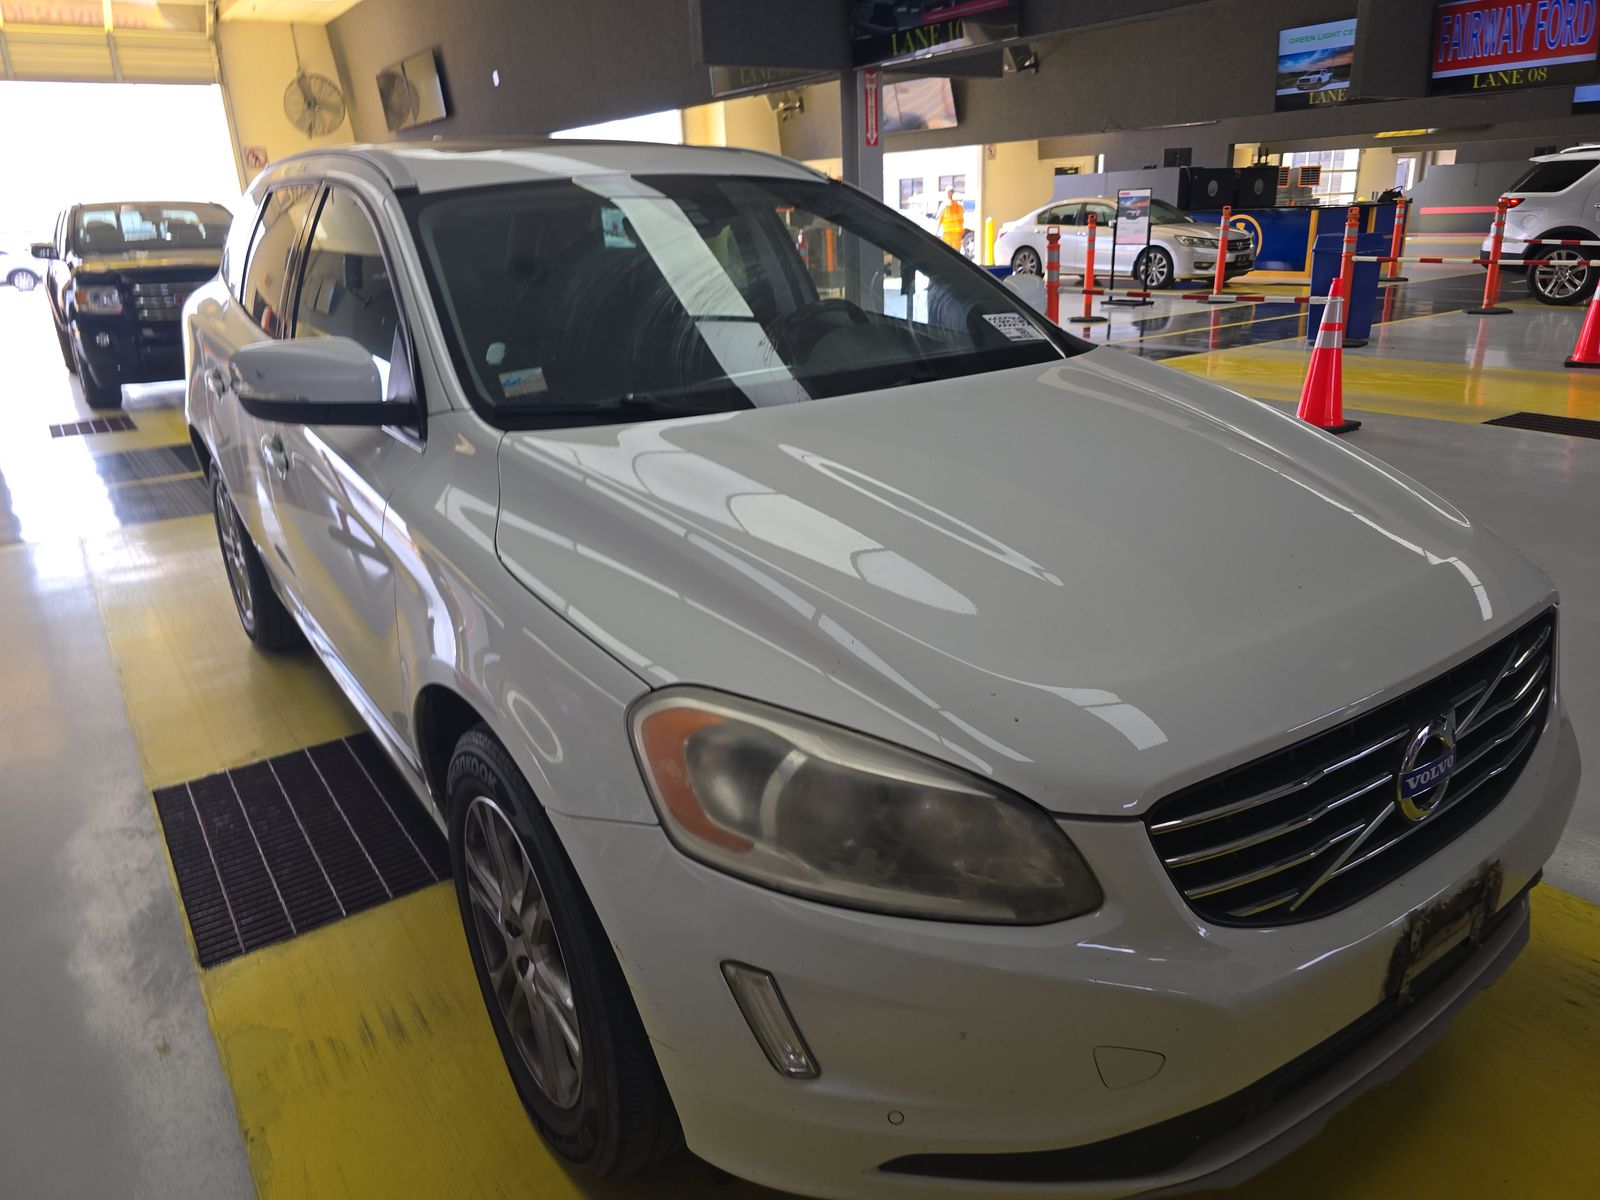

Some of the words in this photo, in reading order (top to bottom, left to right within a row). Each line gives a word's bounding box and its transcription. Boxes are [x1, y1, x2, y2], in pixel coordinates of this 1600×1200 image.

[891, 24, 940, 56] LANE
[1288, 34, 1316, 45] GREEN
[1317, 30, 1342, 41] LIGHT
[1438, 3, 1532, 62] FAIRWAY
[1533, 0, 1596, 50] FORD
[1472, 69, 1524, 89] LANE
[1527, 67, 1548, 82] 08
[1308, 89, 1348, 105] LANE
[1405, 754, 1454, 790] VOLVO
